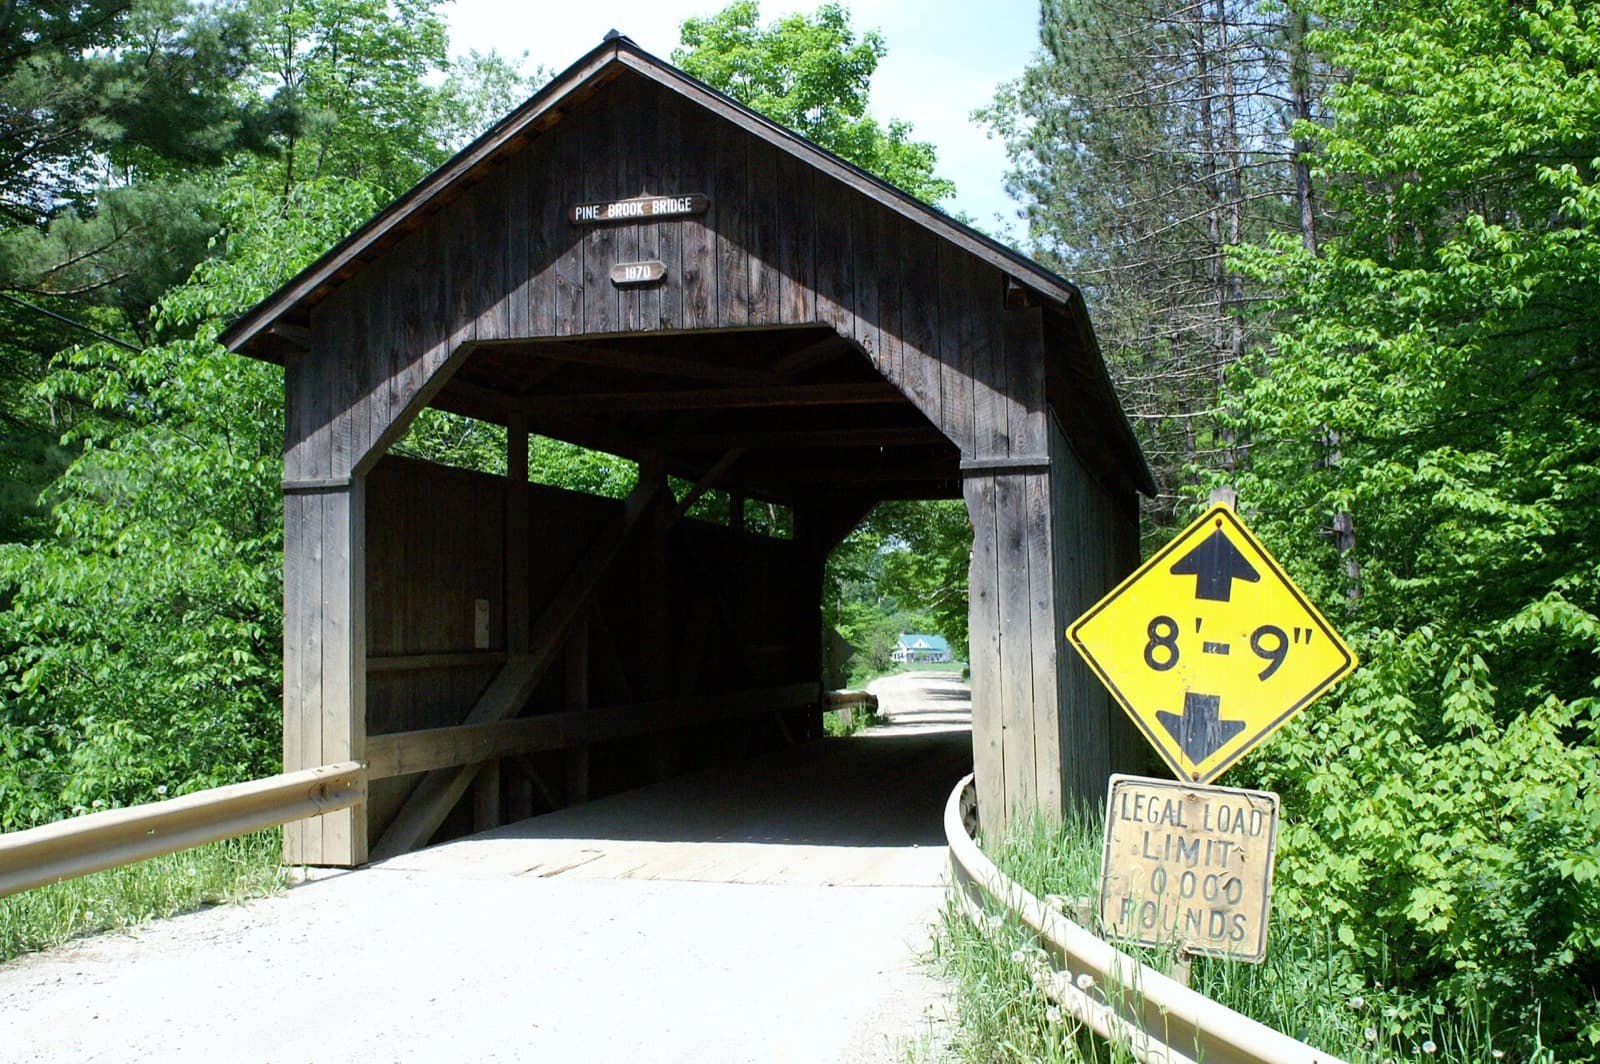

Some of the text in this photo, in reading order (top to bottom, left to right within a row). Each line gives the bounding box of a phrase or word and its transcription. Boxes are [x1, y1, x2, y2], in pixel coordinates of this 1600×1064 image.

[575, 198, 692, 220] PINE BROOK BRIDGE
[625, 266, 651, 280] 1870
[1120, 792, 1264, 837] LEGAL LOAD
[1142, 831, 1235, 868] LIMIT
